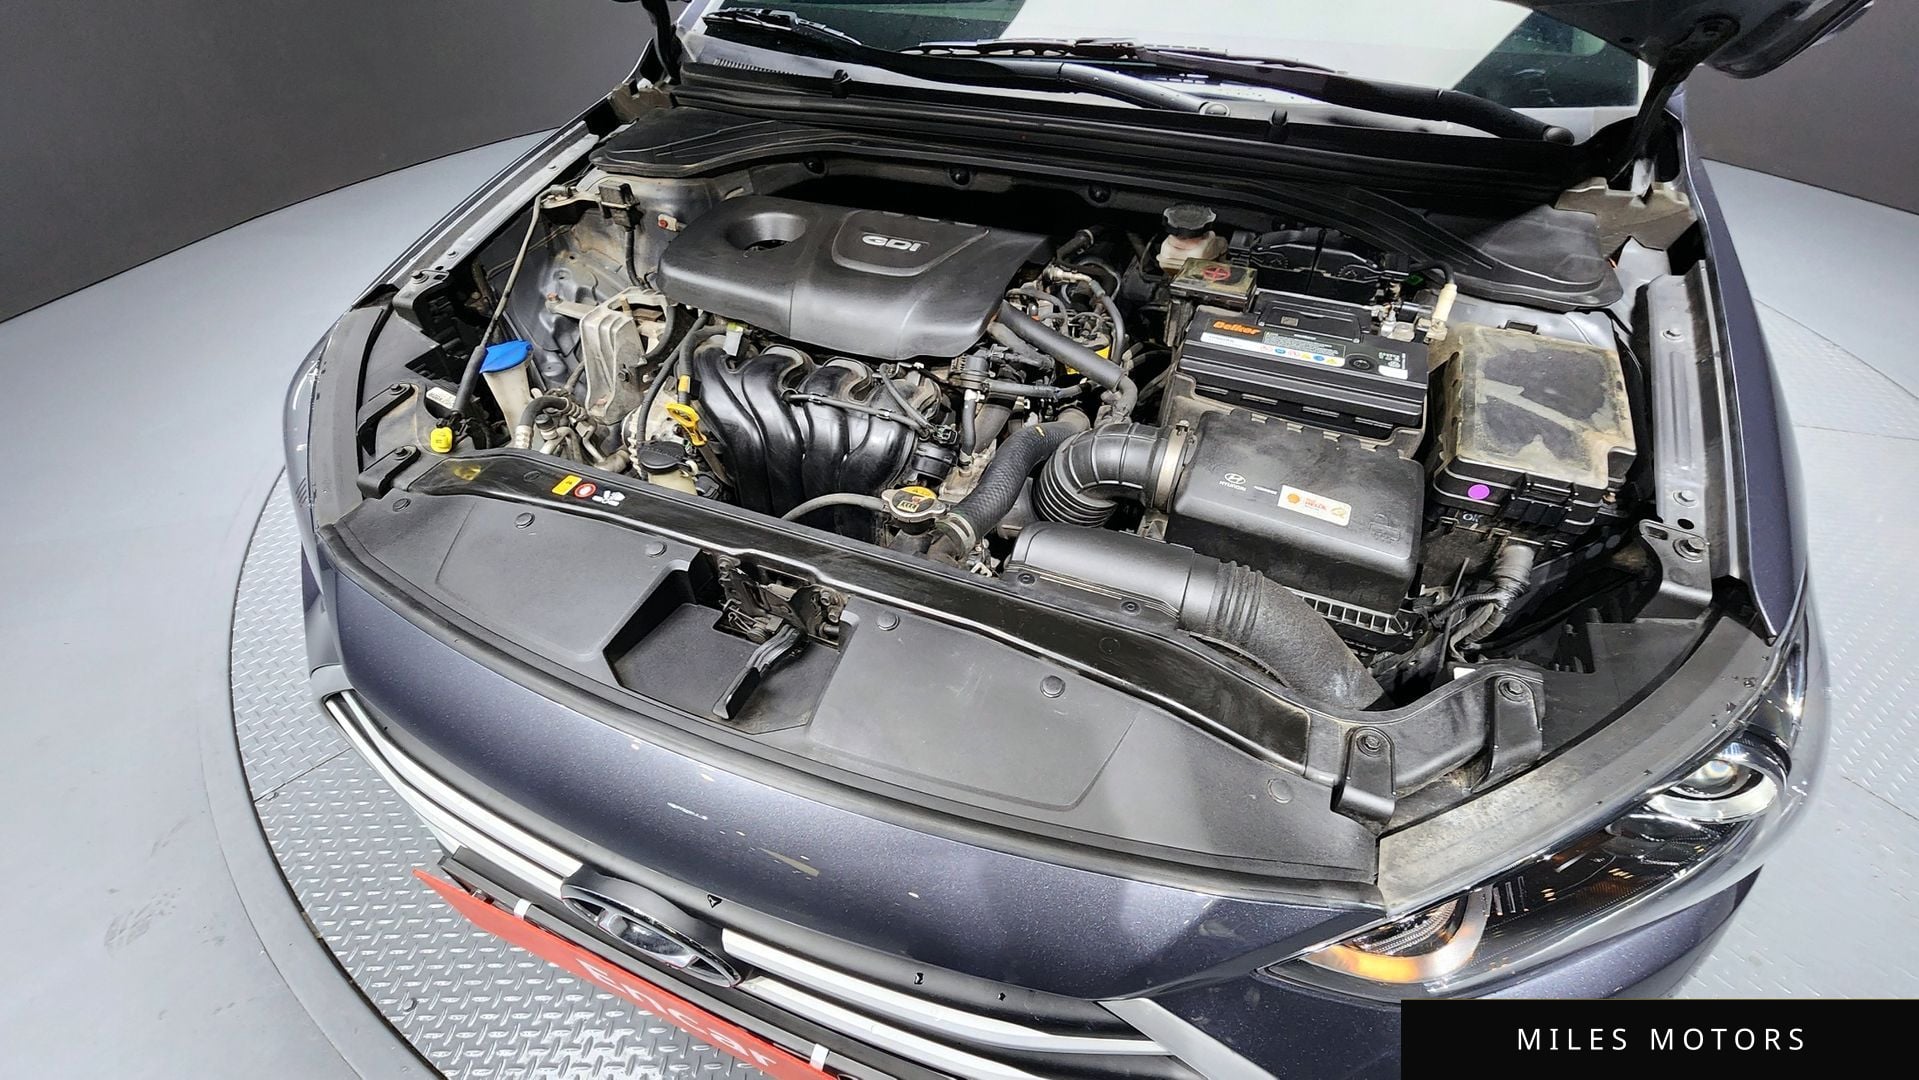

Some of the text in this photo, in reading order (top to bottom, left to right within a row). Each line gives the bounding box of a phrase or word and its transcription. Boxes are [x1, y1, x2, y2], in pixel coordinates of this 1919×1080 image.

[862, 235, 921, 252] GDI
[1219, 480, 1247, 491] HYUNDAI
[576, 957, 777, 1067] Encar
